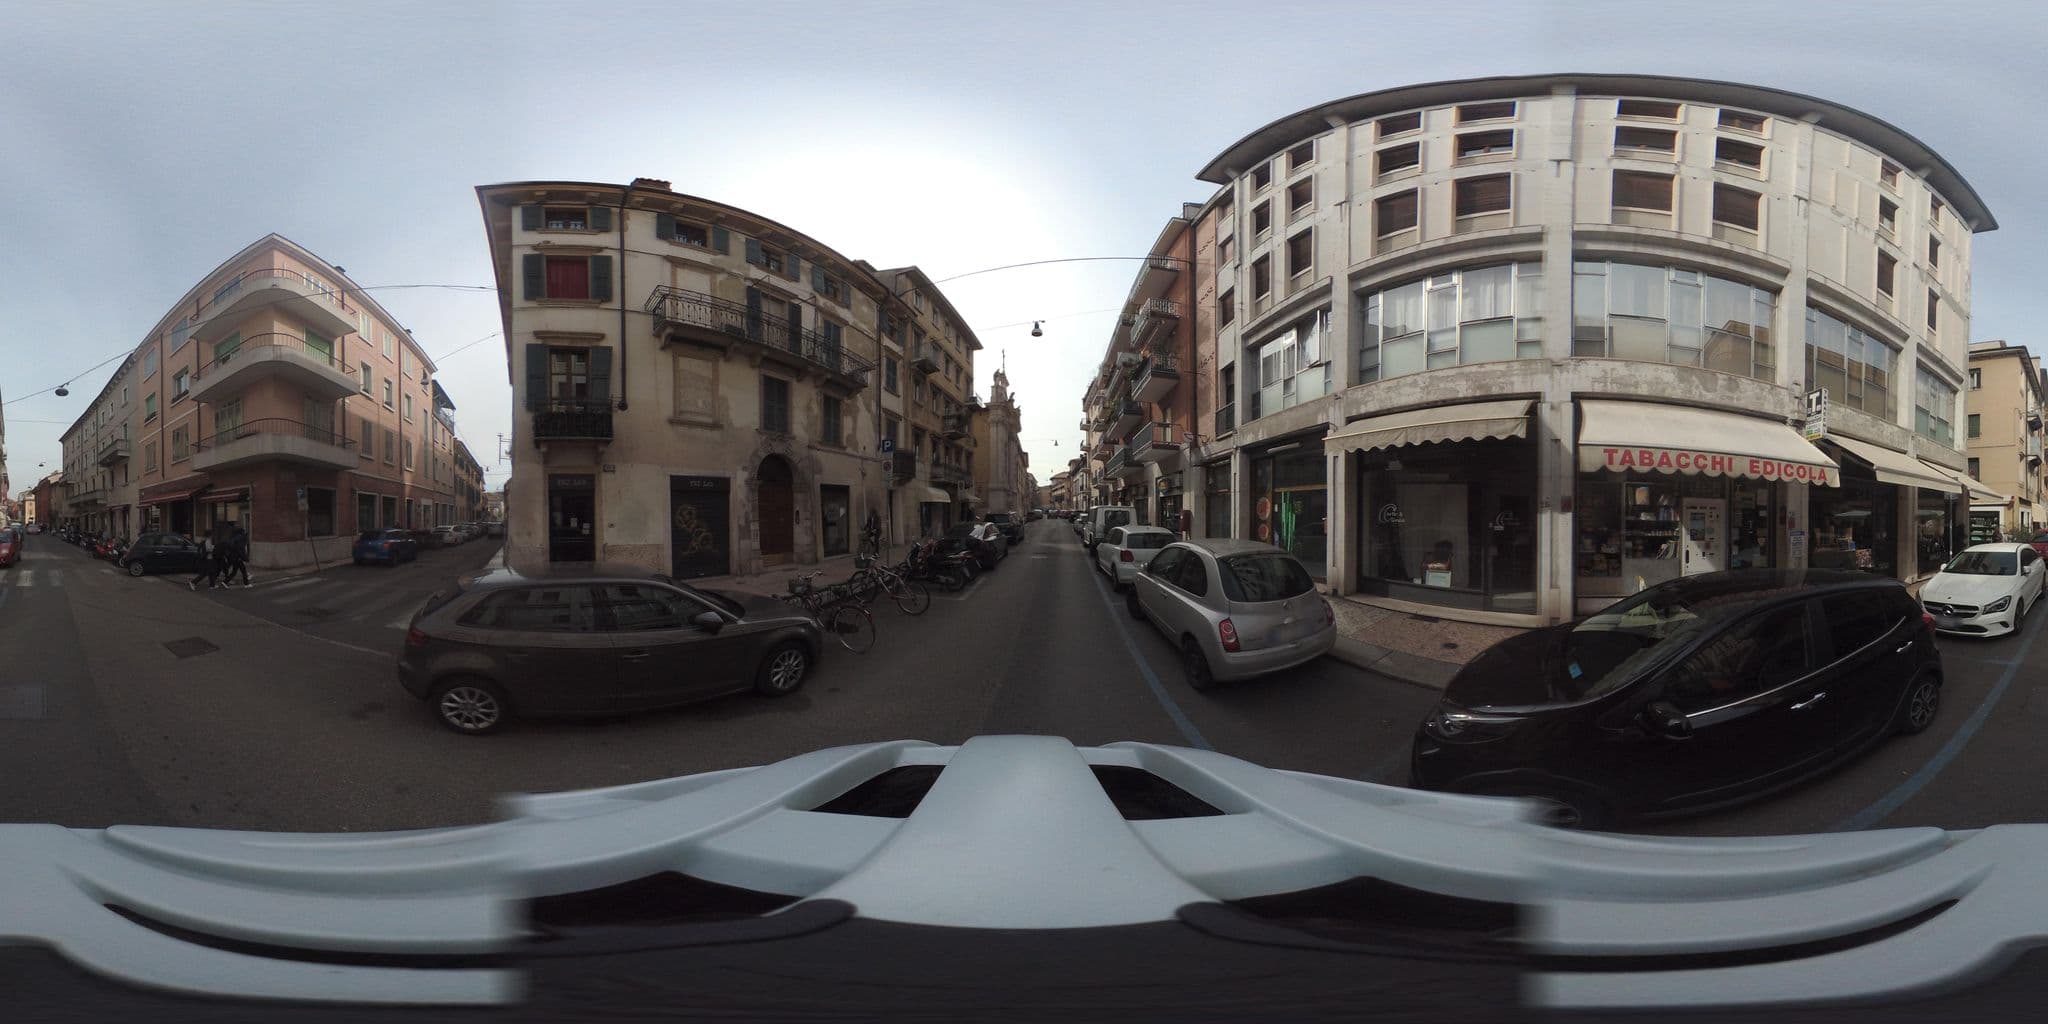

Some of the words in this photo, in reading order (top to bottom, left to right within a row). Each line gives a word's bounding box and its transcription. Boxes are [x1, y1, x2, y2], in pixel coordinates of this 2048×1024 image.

[1809, 391, 1820, 412] T
[884, 441, 891, 450] P
[1603, 448, 1733, 473] TABACCHI
[1749, 459, 1828, 481] EDICOLA
